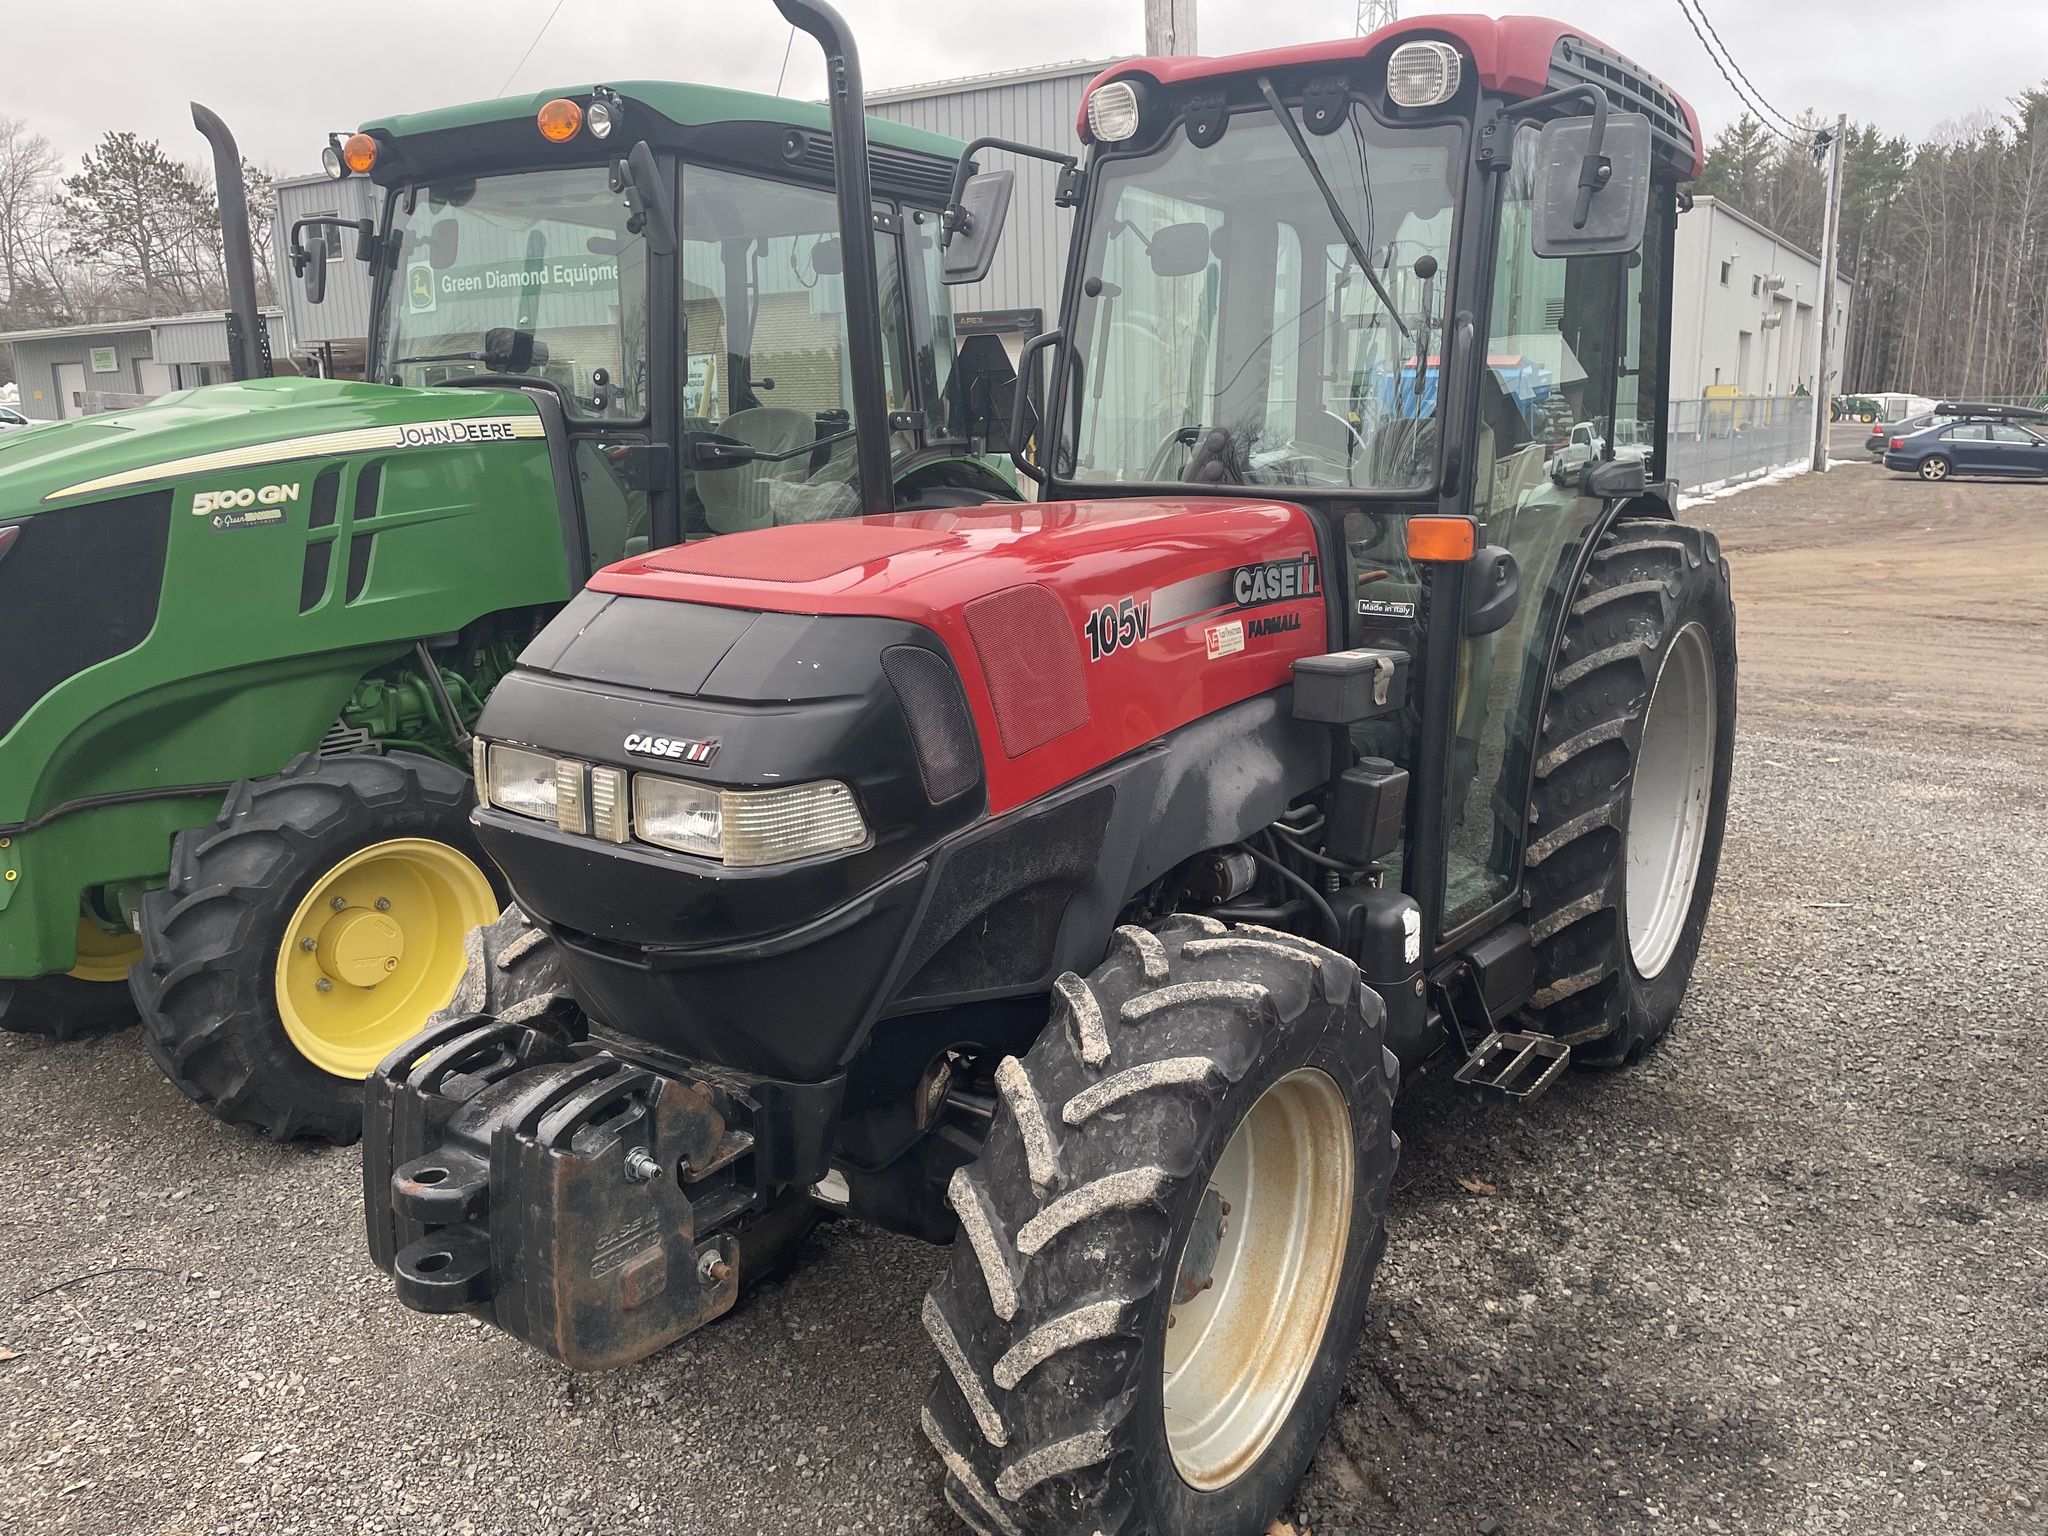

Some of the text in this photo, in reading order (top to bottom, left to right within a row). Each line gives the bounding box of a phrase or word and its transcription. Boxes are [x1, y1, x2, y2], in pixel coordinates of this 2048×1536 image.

[441, 273, 482, 293] Green
[485, 266, 549, 289] Diamond
[960, 317, 984, 325] APEX
[395, 422, 515, 447] JOHN DEERE
[192, 483, 300, 515] 5100 GN
[224, 514, 245, 528] Green
[1235, 563, 1296, 604] CASE
[1362, 603, 1411, 615] Made in Italy
[1247, 613, 1302, 640] FARMALL
[623, 734, 687, 758] CASE
